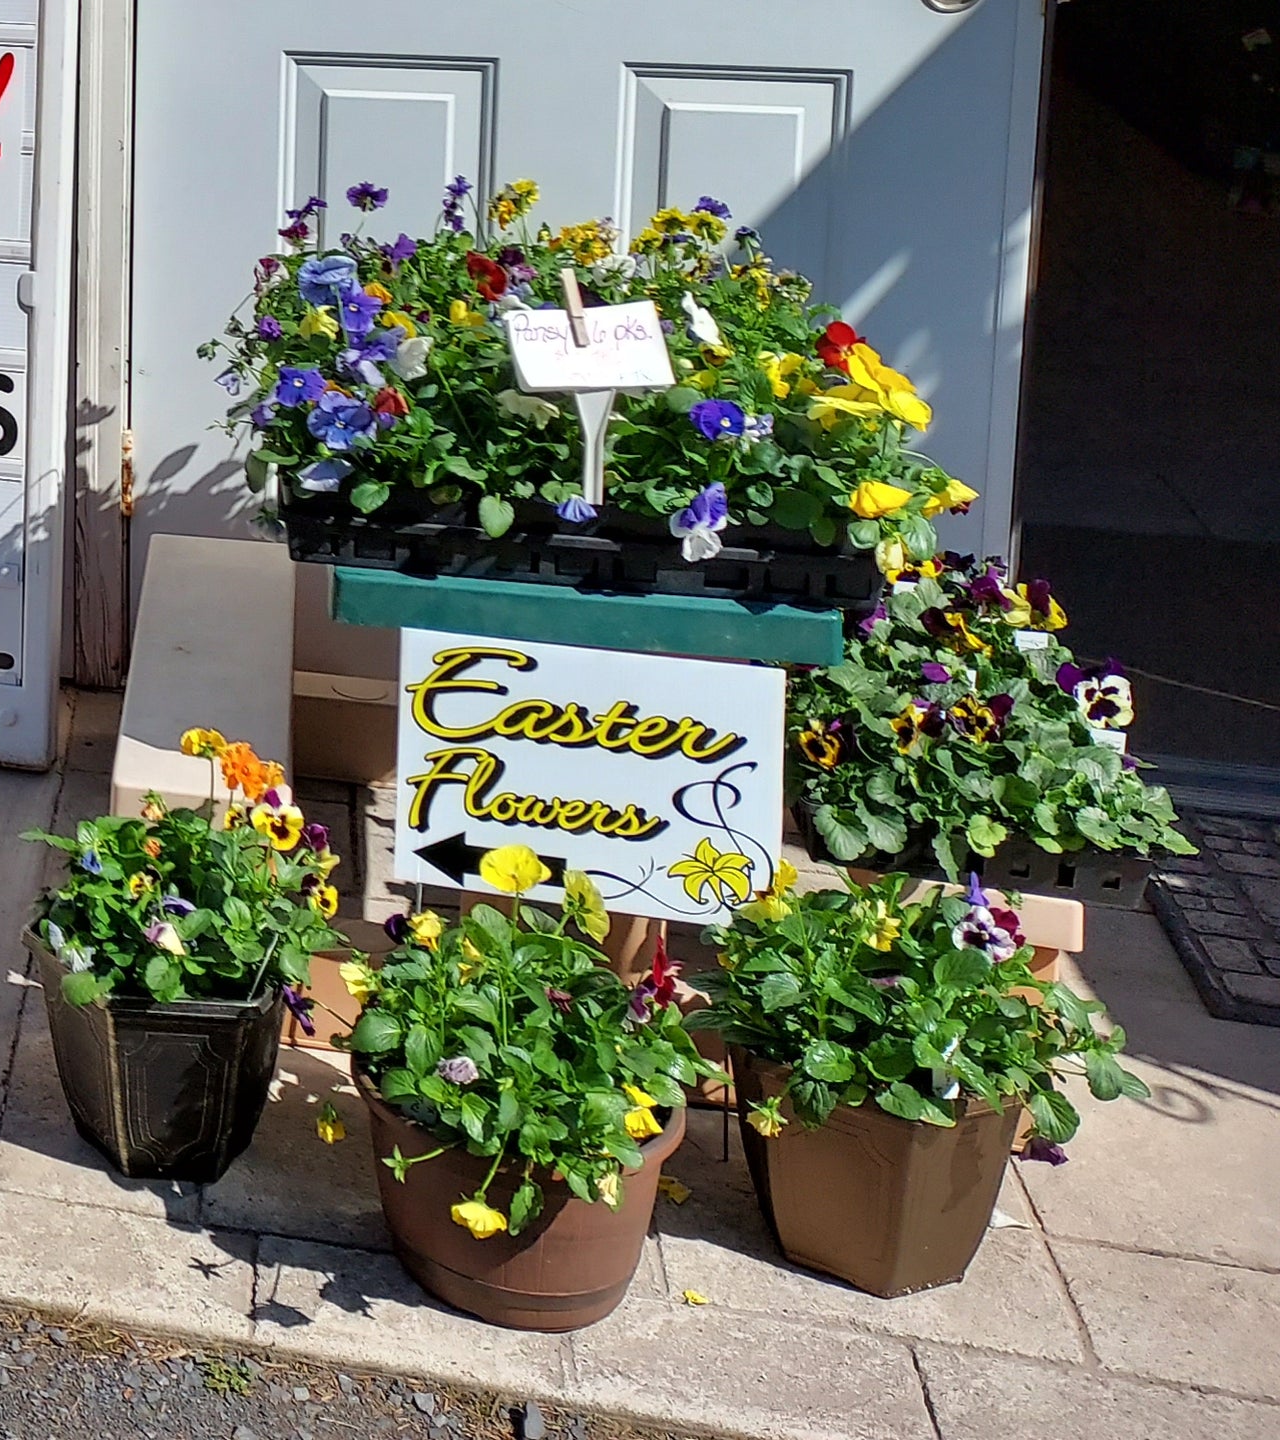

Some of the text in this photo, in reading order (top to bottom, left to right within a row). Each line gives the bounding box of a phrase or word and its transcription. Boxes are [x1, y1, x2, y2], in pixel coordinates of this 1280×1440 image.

[512, 313, 569, 355] Pansy
[592, 320, 607, 344] 6
[406, 646, 746, 764] Easter
[406, 747, 670, 842] Flowers
